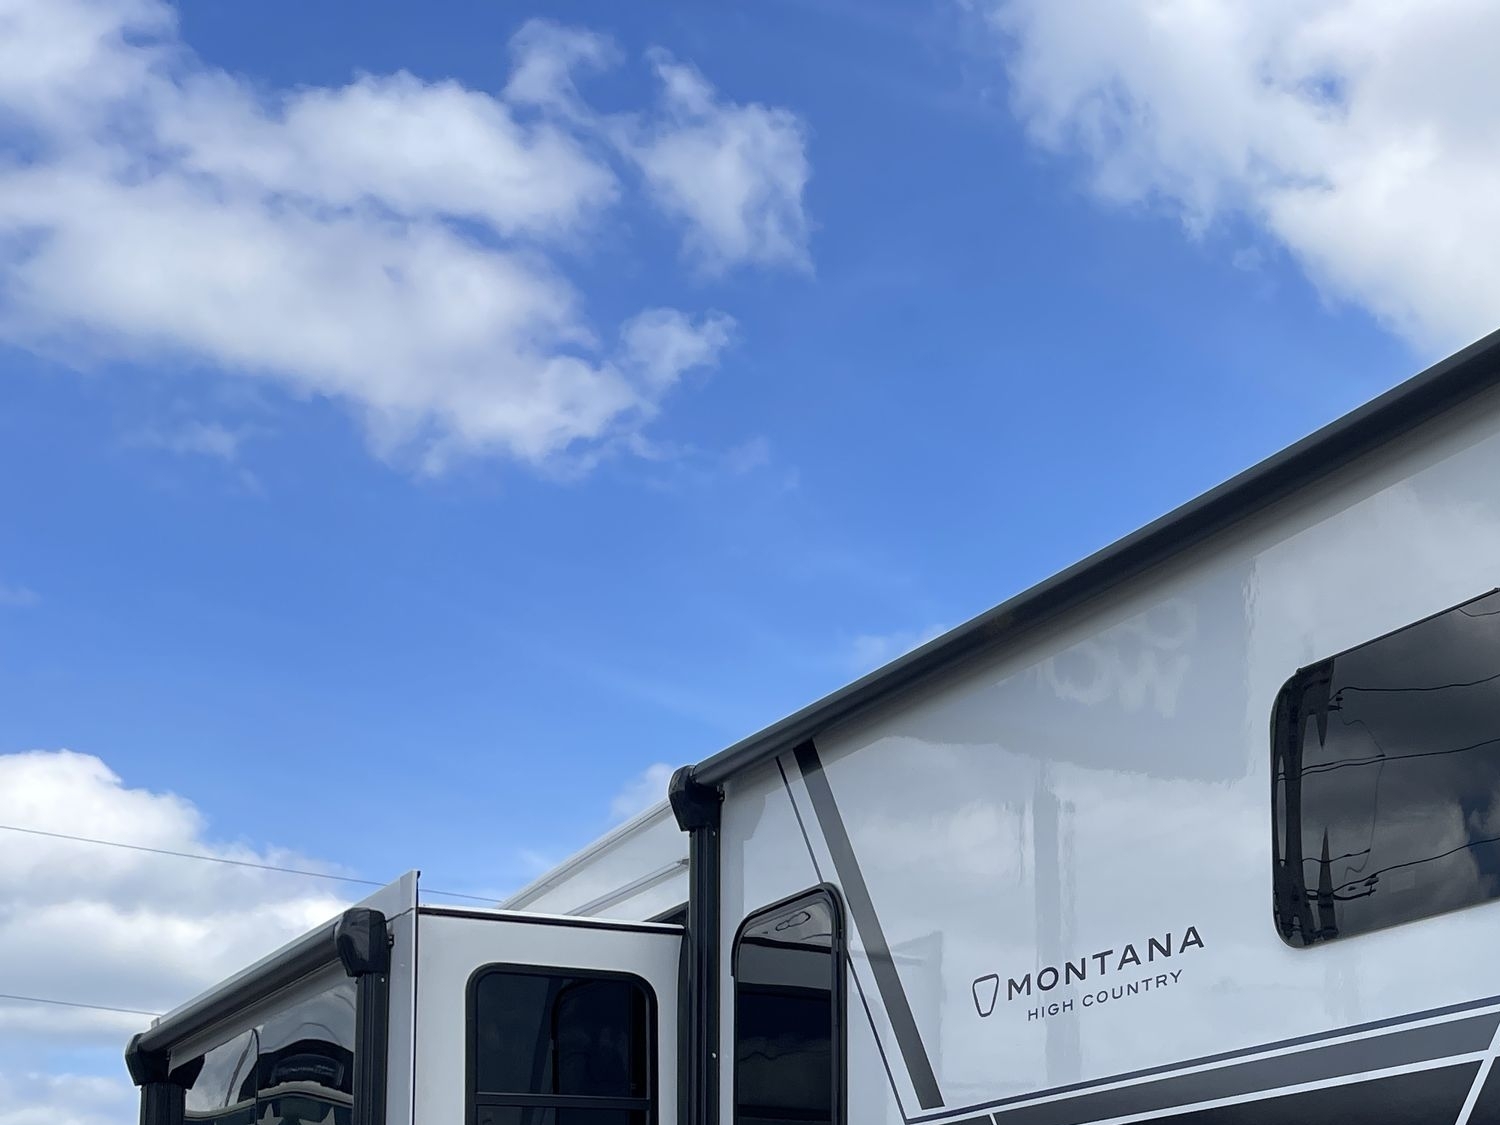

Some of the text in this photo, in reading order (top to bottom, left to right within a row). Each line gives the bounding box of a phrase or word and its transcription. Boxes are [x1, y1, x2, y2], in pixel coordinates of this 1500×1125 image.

[1007, 926, 1204, 1001] MONTANA
[1027, 969, 1183, 1021] HIGH COUNTRY
